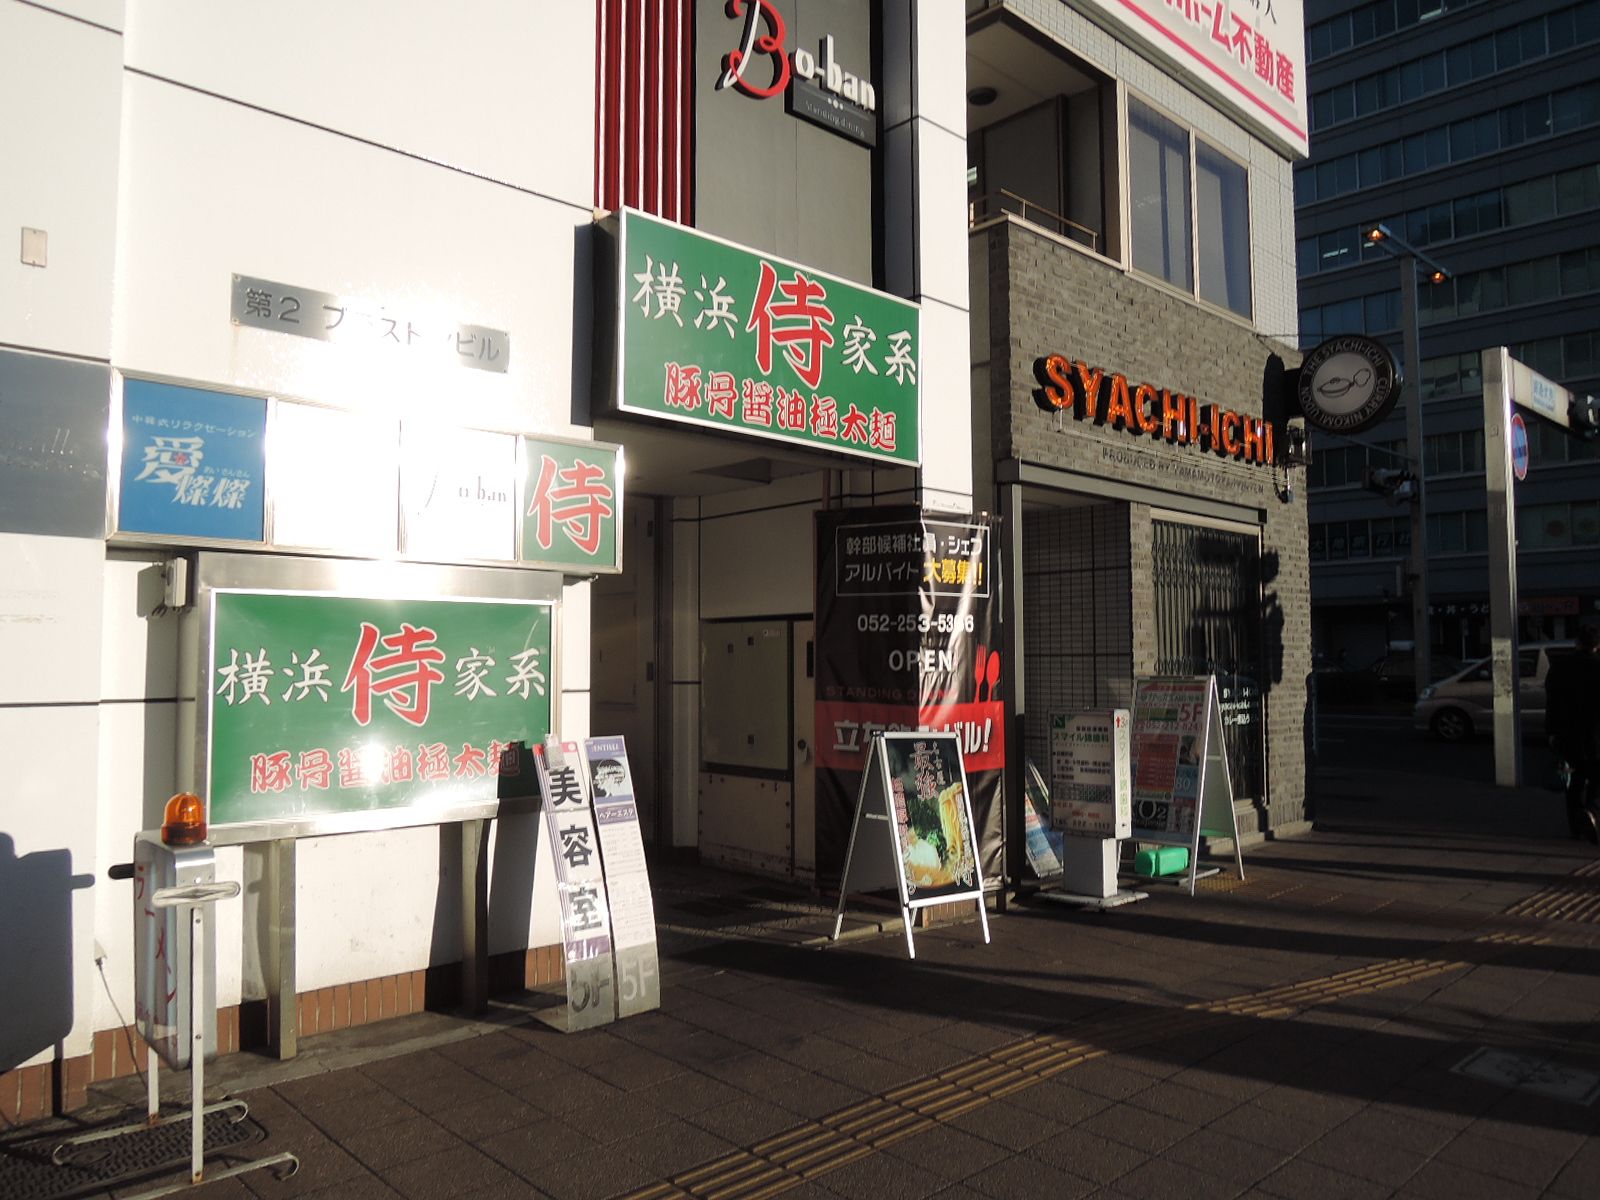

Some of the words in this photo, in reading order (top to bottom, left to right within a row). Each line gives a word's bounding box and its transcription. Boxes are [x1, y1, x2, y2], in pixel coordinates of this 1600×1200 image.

[1102, 446, 1156, 471] PRODUCED
[527, 453, 613, 556] 侍
[844, 561, 920, 583] アルバイト
[857, 613, 975, 634] 052-253-536
[888, 649, 952, 673] OPEN
[550, 766, 603, 931] 美容室
